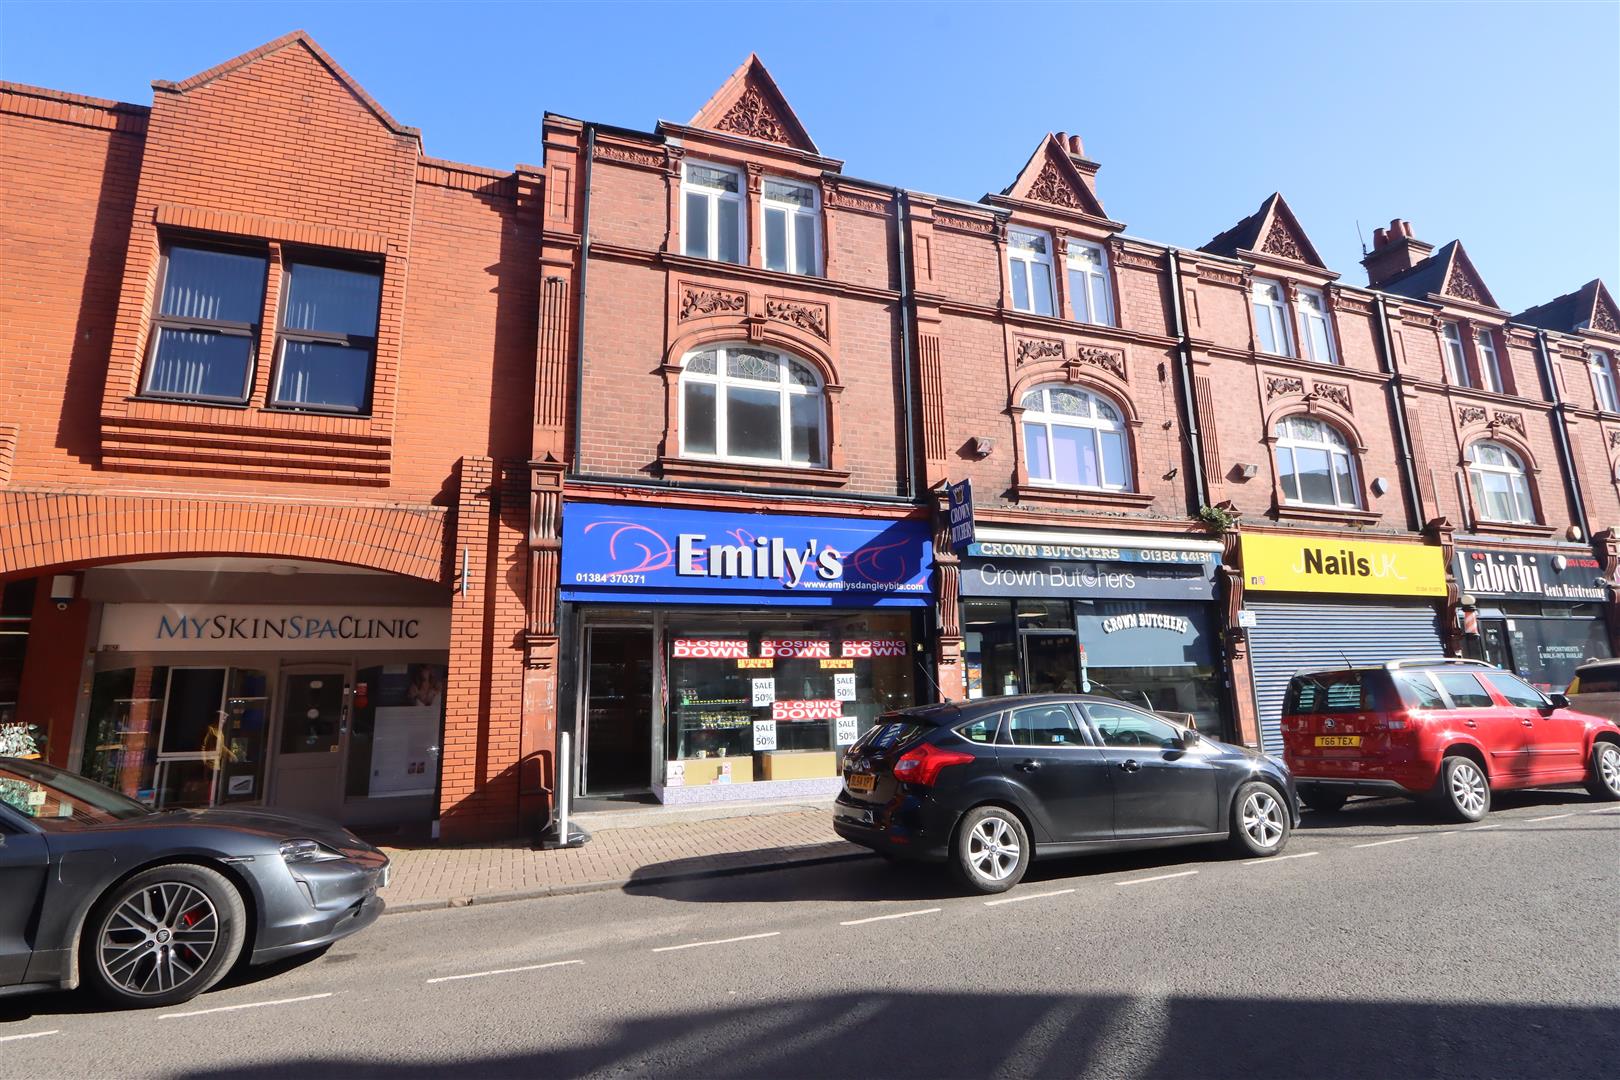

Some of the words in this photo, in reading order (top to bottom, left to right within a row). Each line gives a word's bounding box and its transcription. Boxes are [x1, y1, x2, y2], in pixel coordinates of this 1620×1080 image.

[951, 503, 971, 524] CROWN
[952, 521, 972, 543] BUTCHERS
[980, 543, 1038, 556] CROWN
[1042, 545, 1121, 559] BUTCHERS
[1140, 550, 1178, 562] 01384
[678, 533, 844, 588] Emily's
[576, 573, 607, 583] 01384
[610, 573, 645, 584] 370371
[980, 563, 1045, 586] Crown
[1050, 565, 1136, 589] Butchers
[1544, 583, 1563, 597] Gents
[1563, 583, 1606, 601] Hairdressing
[1102, 613, 1137, 633] CROWN
[1138, 613, 1188, 633] BUTCHERS
[674, 639, 748, 648] CLOSING
[760, 640, 830, 648] CLOSING
[842, 640, 906, 648] CLOSING
[673, 647, 748, 657] DOWN
[760, 647, 830, 657] DOWN
[841, 647, 906, 657] DOWN
[836, 677, 853, 685] SALE
[836, 688, 854, 697] 50%
[754, 693, 773, 702] 50%
[773, 701, 841, 710] CLOSING
[773, 709, 841, 719] DOWN
[755, 724, 774, 732] SALE
[838, 720, 855, 728] SALE
[838, 732, 856, 740] 50%
[756, 737, 774, 745] 50%
[1320, 737, 1335, 745] T66
[1336, 737, 1353, 745] TEX
